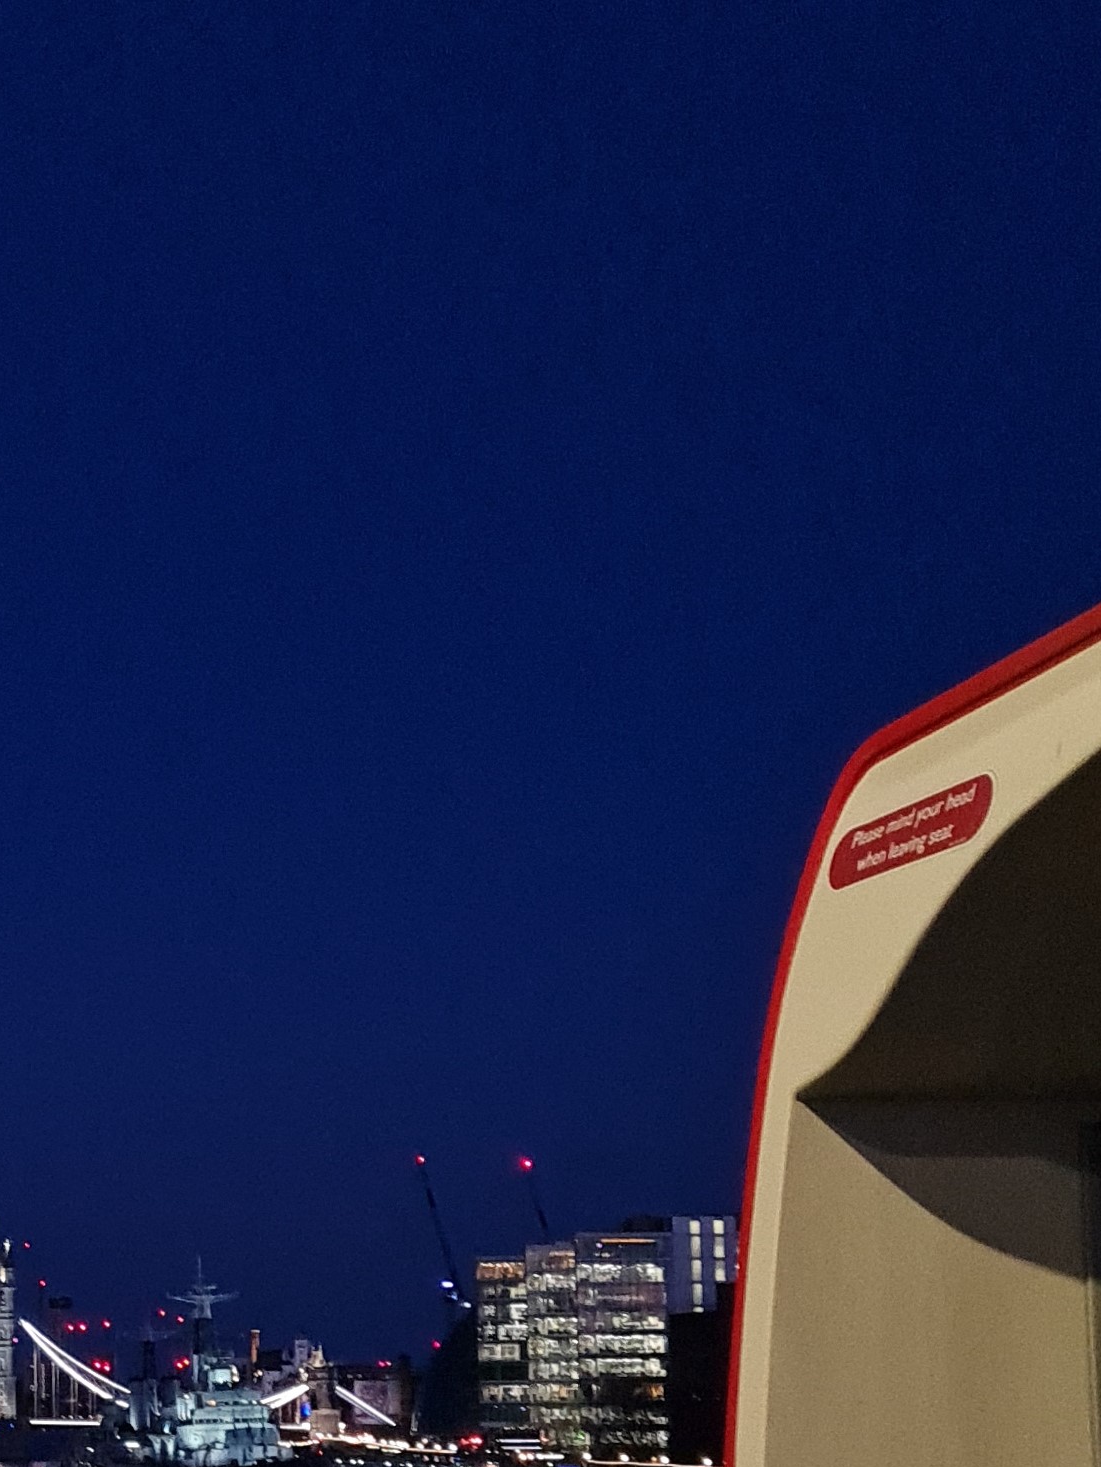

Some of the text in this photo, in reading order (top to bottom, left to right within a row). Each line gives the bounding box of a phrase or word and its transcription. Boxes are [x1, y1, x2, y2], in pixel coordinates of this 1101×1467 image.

[850, 783, 977, 849] Please mind your head
[857, 851, 887, 871] when
[887, 834, 928, 859] leaving
[927, 823, 955, 845] seat
